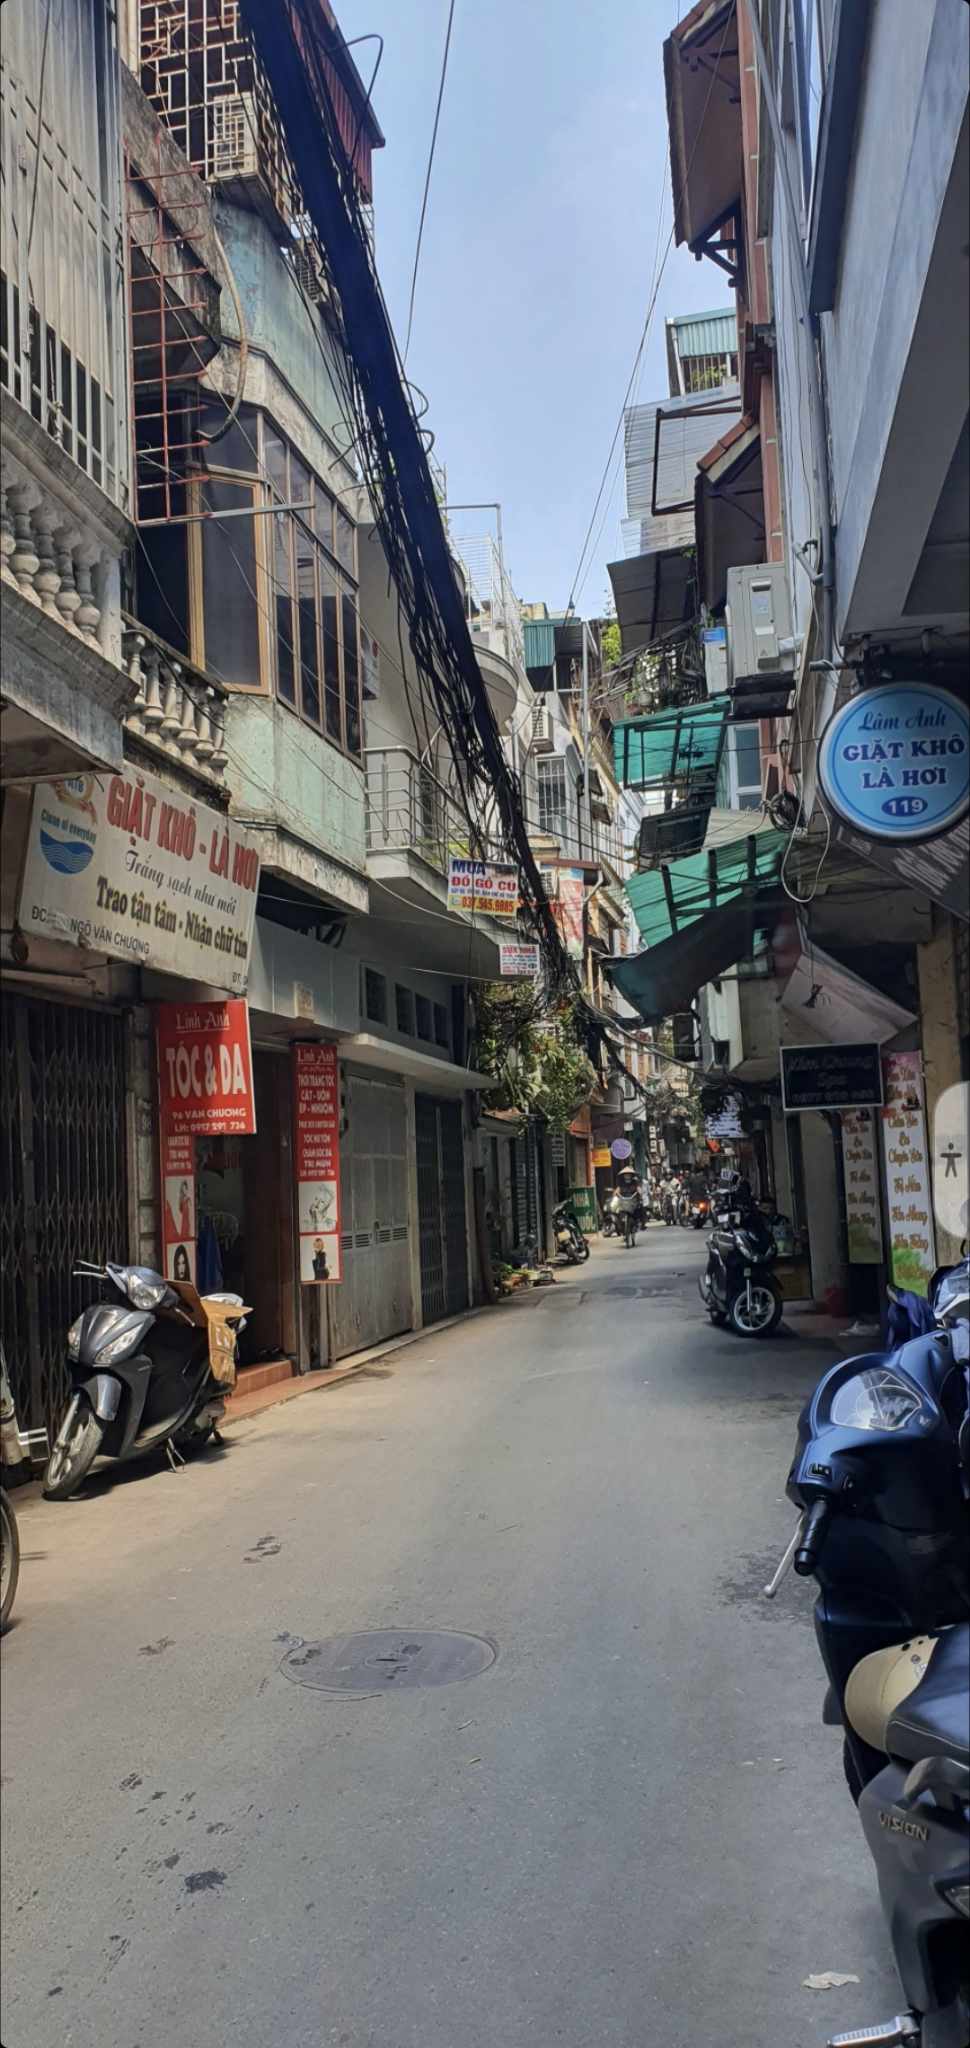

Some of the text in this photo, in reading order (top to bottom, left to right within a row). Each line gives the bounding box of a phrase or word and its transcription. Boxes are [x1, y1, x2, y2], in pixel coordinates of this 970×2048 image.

[858, 707, 947, 731] Lâm Anh
[843, 734, 965, 763] GIẶT KHÔ
[863, 767, 947, 789] LÀ HƠI
[888, 799, 923, 815] 119
[106, 775, 157, 846] GIẶT
[157, 801, 197, 861] KHÔ
[209, 826, 230, 879] LÀ
[124, 849, 164, 889] Trắng
[168, 874, 192, 896] sạch
[452, 861, 485, 875] MUA
[96, 875, 128, 915] Trao
[131, 891, 151, 927] tận
[155, 901, 176, 933] tâm
[184, 910, 212, 950] Nhận
[214, 926, 235, 952] chữ
[176, 1009, 230, 1030] Linh Anh
[165, 1041, 247, 1099] TÓC & DA
[879, 1811, 929, 1842] VISION
